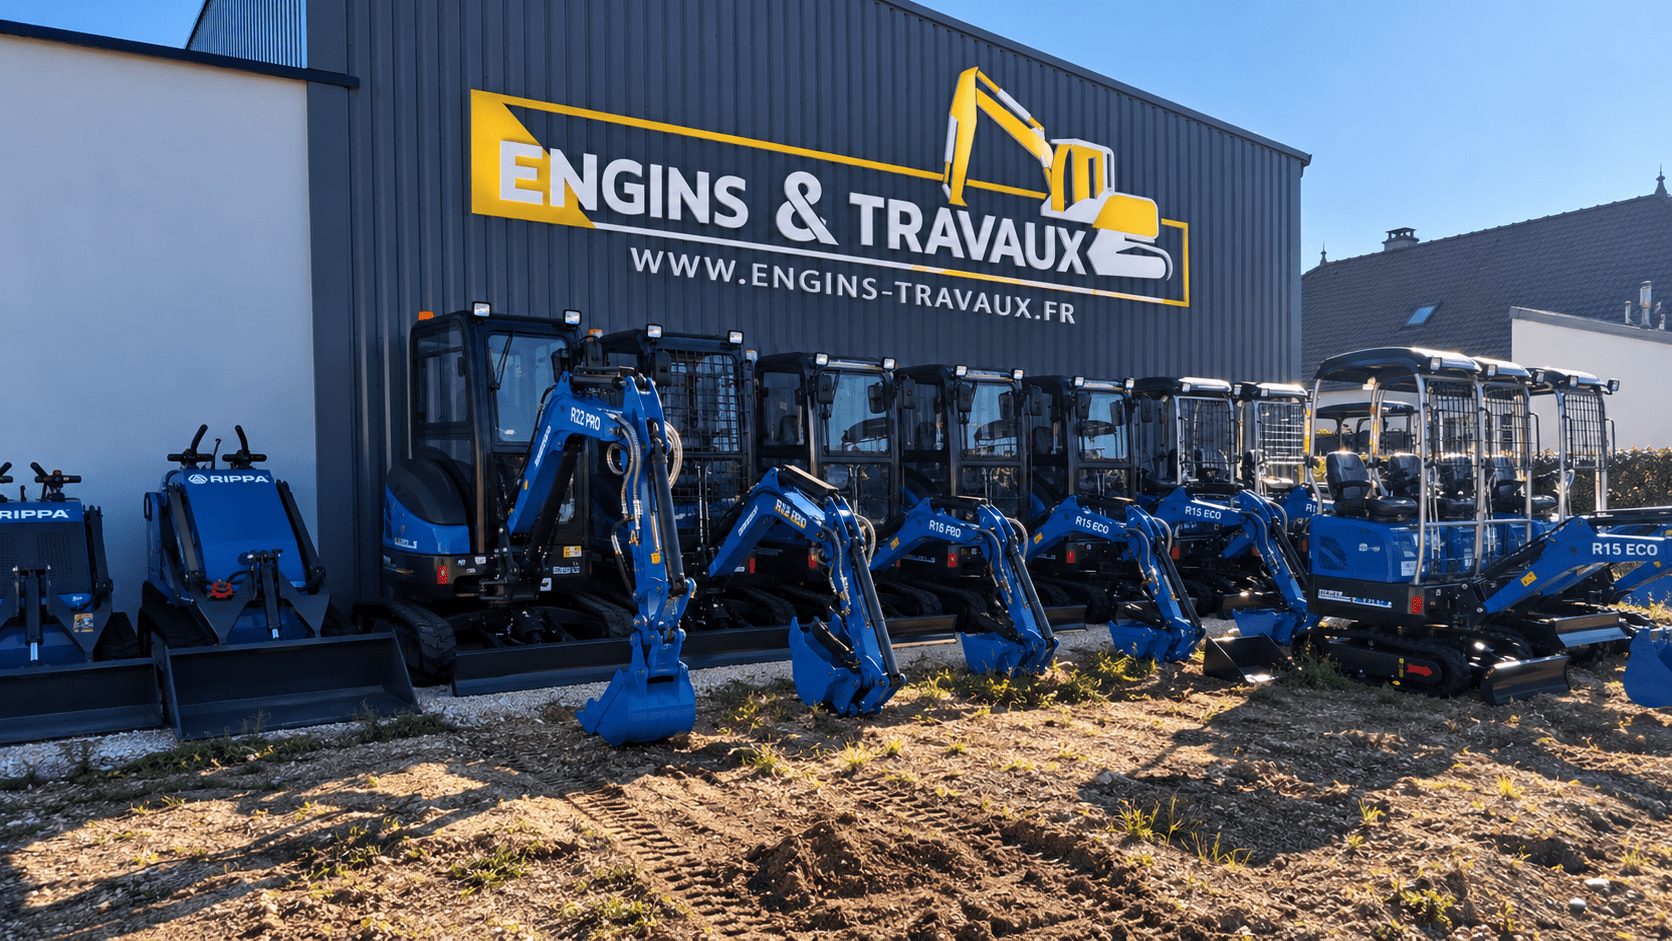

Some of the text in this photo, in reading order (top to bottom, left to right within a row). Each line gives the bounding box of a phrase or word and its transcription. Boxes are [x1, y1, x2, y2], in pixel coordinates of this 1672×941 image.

[499, 139, 1088, 277] ENGINS & TRAVAUX
[629, 246, 1077, 325] WWW.ENGINS-TRAVAUX.FR
[570, 406, 601, 431] R22 PRO
[209, 474, 270, 484] RIPPA
[0, 509, 70, 520] RIPPA
[1185, 505, 1222, 520] R15 ECO
[1075, 515, 1110, 535] R15 ECO
[1592, 541, 1658, 556] R15 ECO
